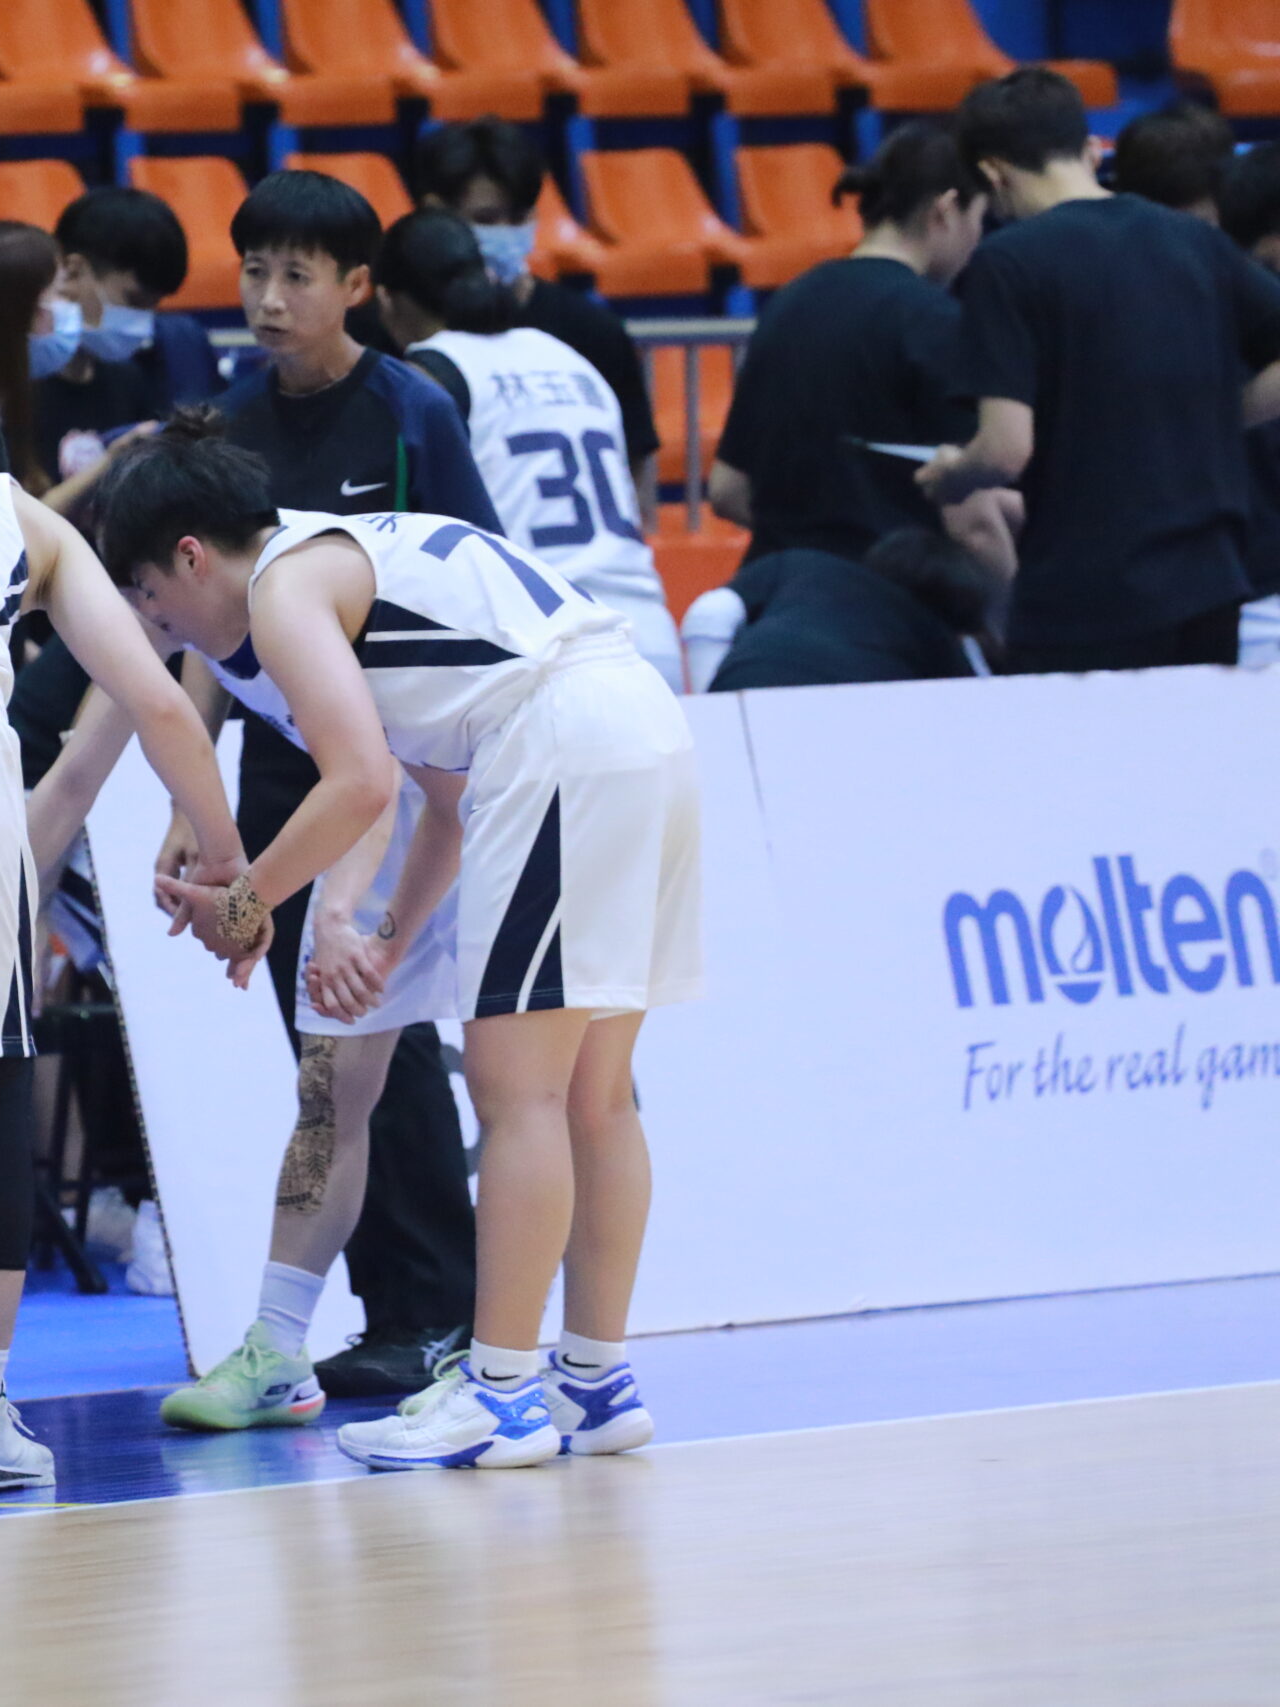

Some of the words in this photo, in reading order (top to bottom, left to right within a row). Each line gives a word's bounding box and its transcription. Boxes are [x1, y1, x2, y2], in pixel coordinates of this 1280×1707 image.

[505, 429, 644, 549] 30
[420, 523, 594, 618] 7
[943, 854, 1280, 1008] molten
[963, 1040, 1024, 1111] For
[1032, 1031, 1096, 1098] the
[1105, 1021, 1186, 1092] real
